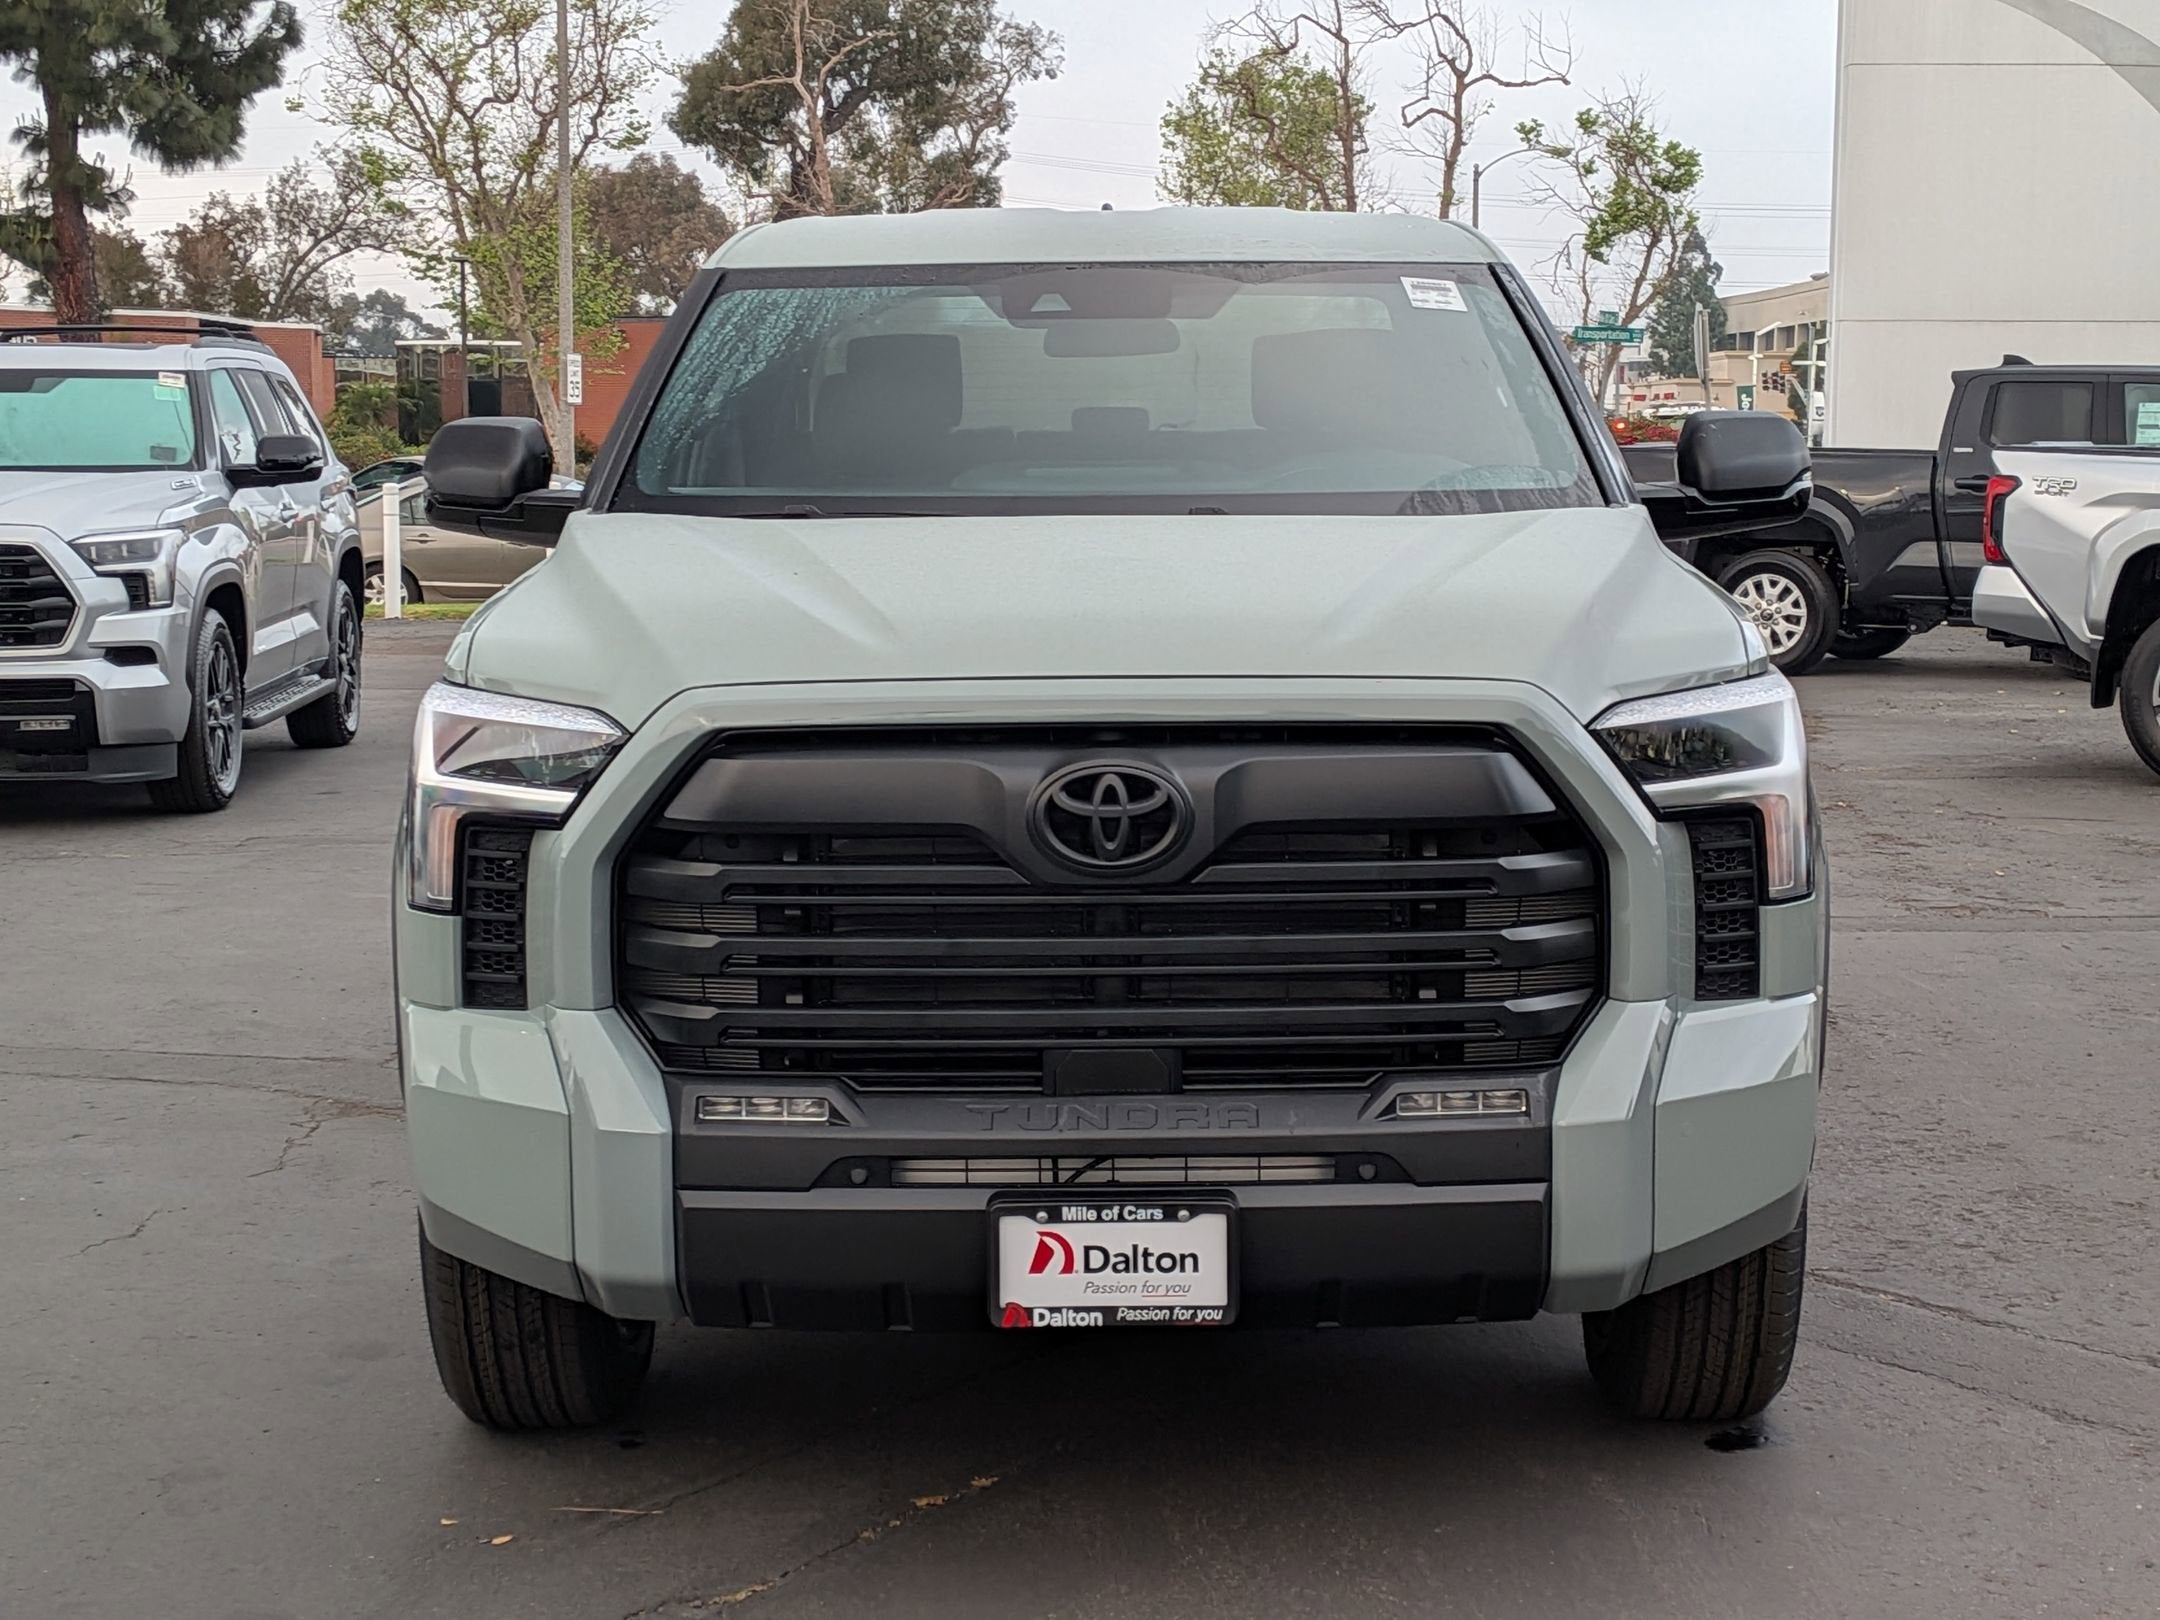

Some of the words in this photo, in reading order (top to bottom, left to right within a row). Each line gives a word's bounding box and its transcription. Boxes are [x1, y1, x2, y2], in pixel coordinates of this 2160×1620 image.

[1577, 328, 1630, 340] Transportation
[965, 1103, 1260, 1131] TUNDRA
[1062, 1207, 1097, 1221] Mile
[1102, 1205, 1120, 1220] of
[1123, 1207, 1164, 1220] Cars
[1083, 1244, 1199, 1274] Dalton
[1083, 1281, 1137, 1294] Passion
[1141, 1280, 1162, 1294] for
[1164, 1283, 1191, 1297] you
[1033, 1308, 1103, 1327] Dalton
[1116, 1307, 1169, 1321] Passion
[1173, 1306, 1194, 1321] for
[1195, 1308, 1223, 1323] you
